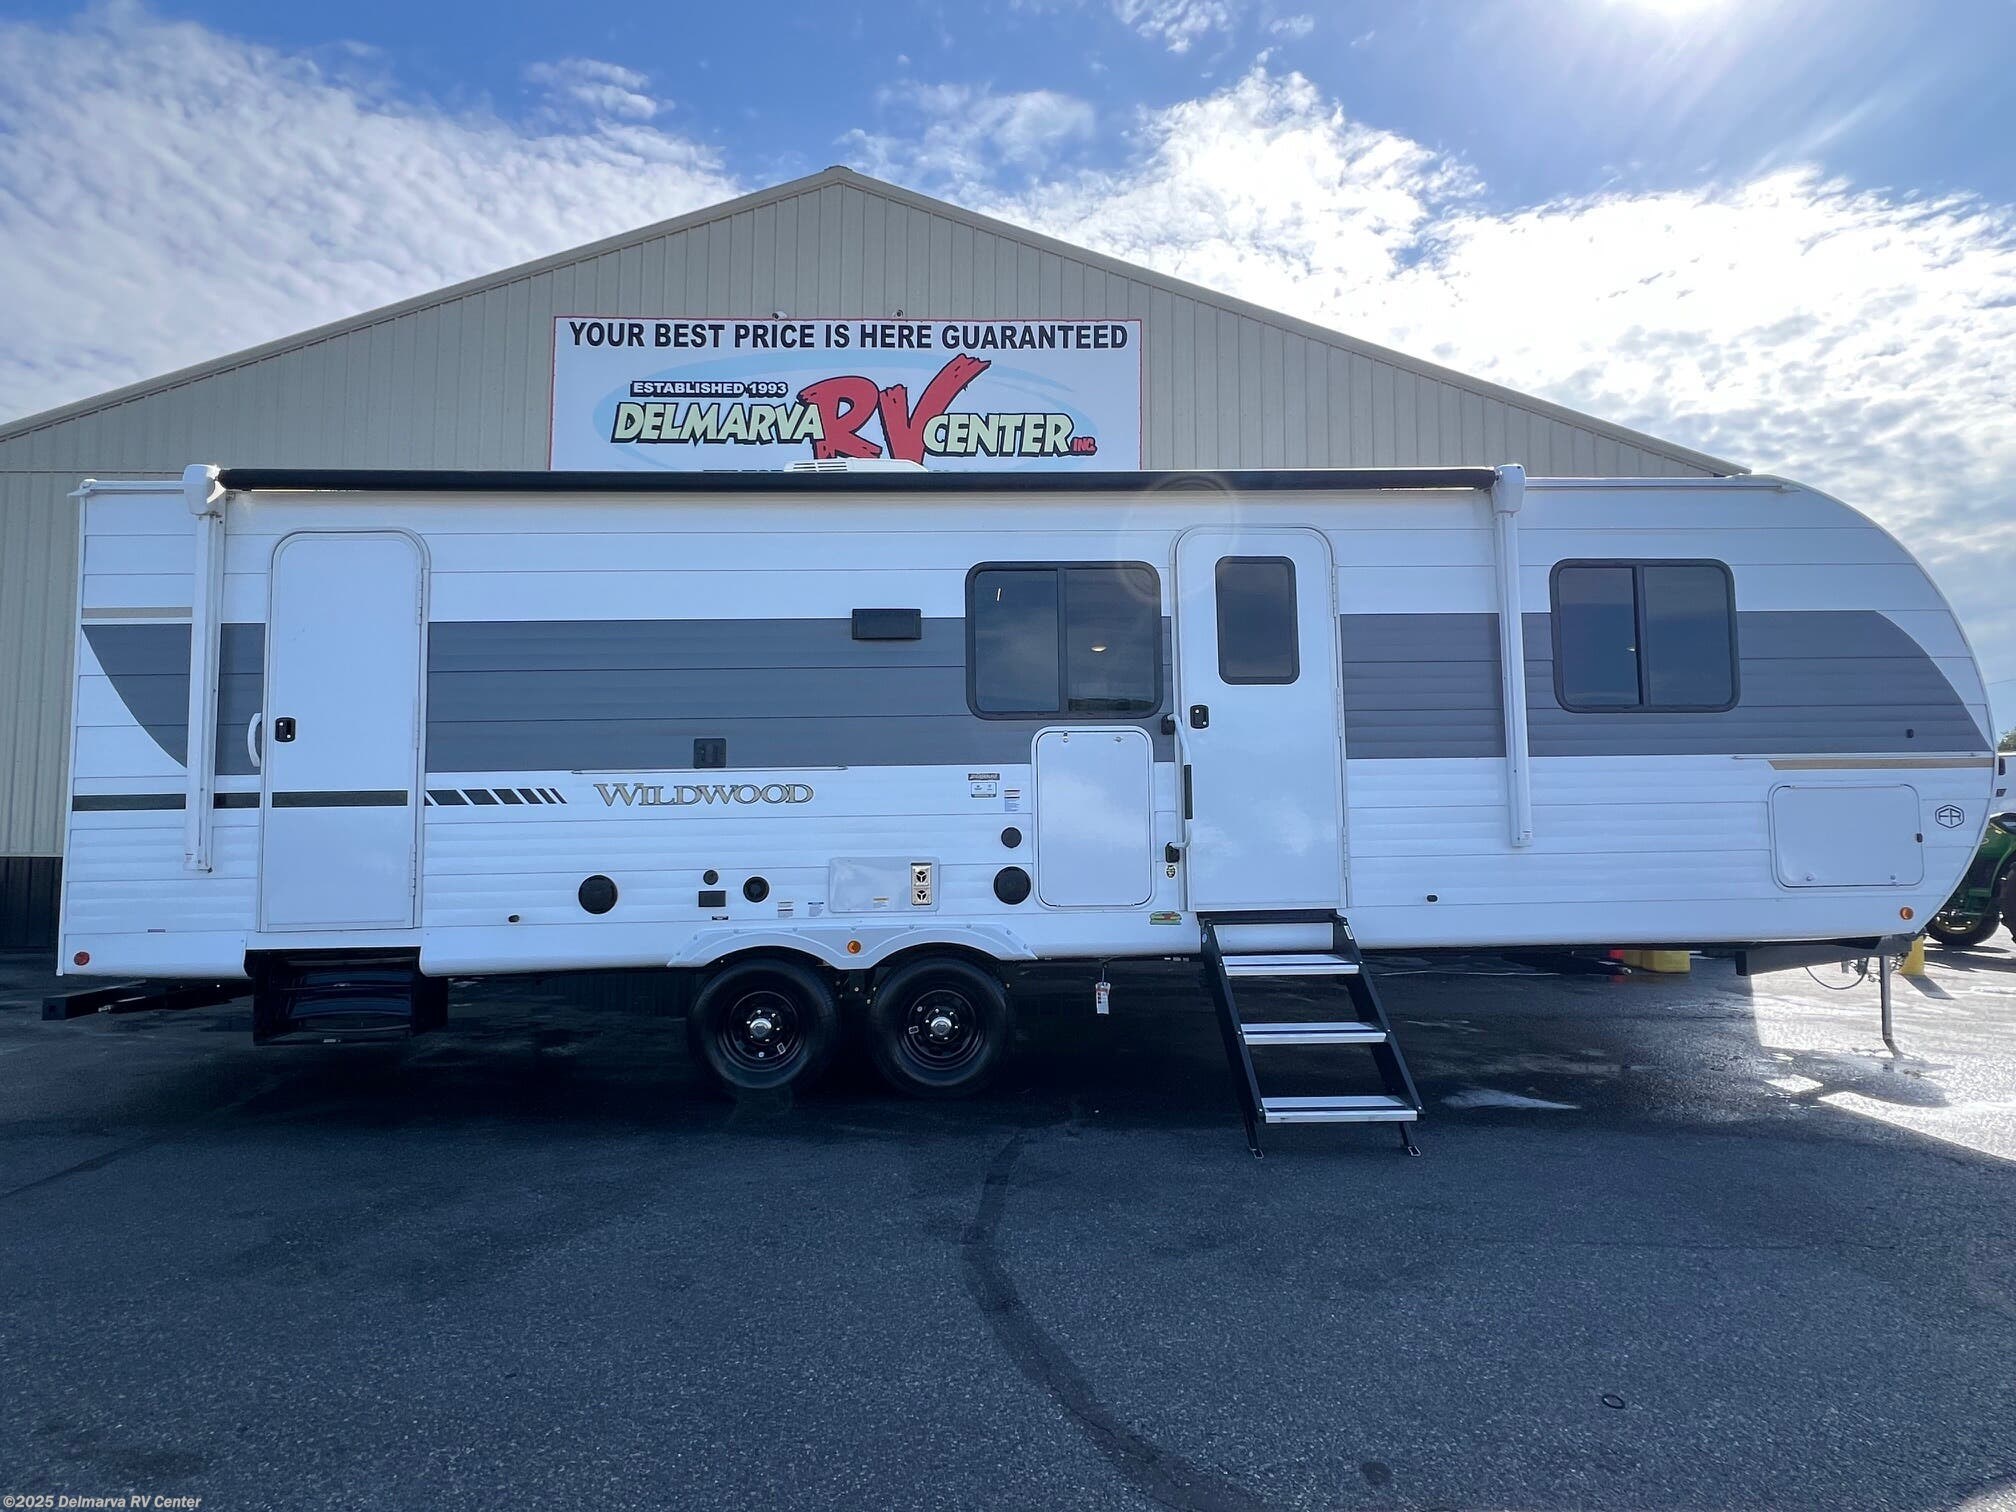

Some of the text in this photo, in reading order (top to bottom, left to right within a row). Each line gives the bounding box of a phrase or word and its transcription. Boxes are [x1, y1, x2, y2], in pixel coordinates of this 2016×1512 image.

[569, 321, 1128, 350] YOUR BEST PRICE IS HERE GUARANTEED
[632, 381, 788, 395] ESTABLISHED 1993
[611, 402, 826, 444] DELMARVA
[797, 353, 991, 465] RV
[923, 413, 1074, 457] CENTER
